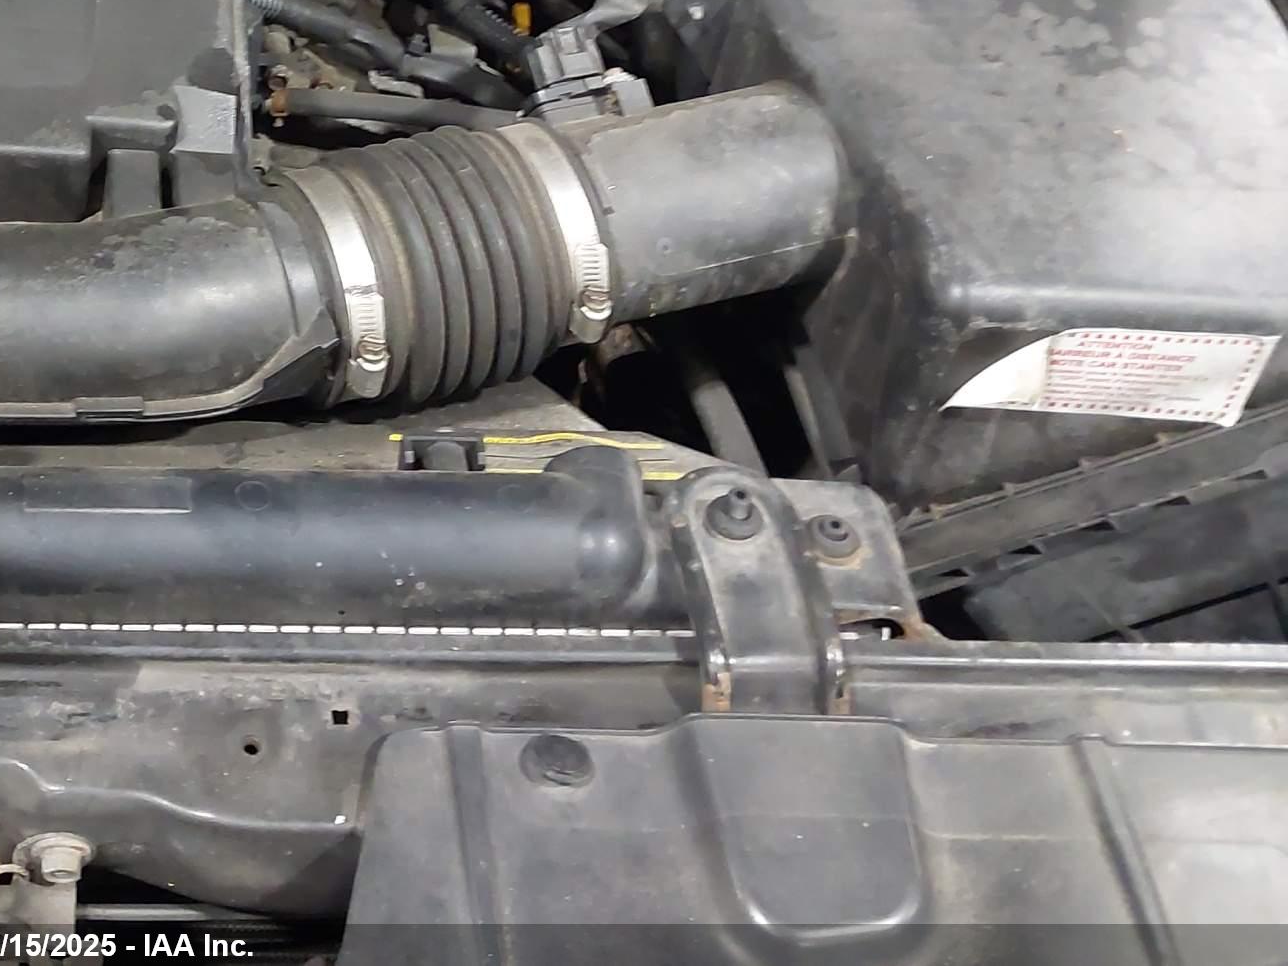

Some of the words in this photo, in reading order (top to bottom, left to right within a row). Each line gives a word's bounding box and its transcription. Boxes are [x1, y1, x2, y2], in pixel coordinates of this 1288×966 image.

[1078, 340, 1153, 350] ATTENTION
[1127, 352, 1197, 363] DISTANCE
[1122, 362, 1184, 373] STARTER
